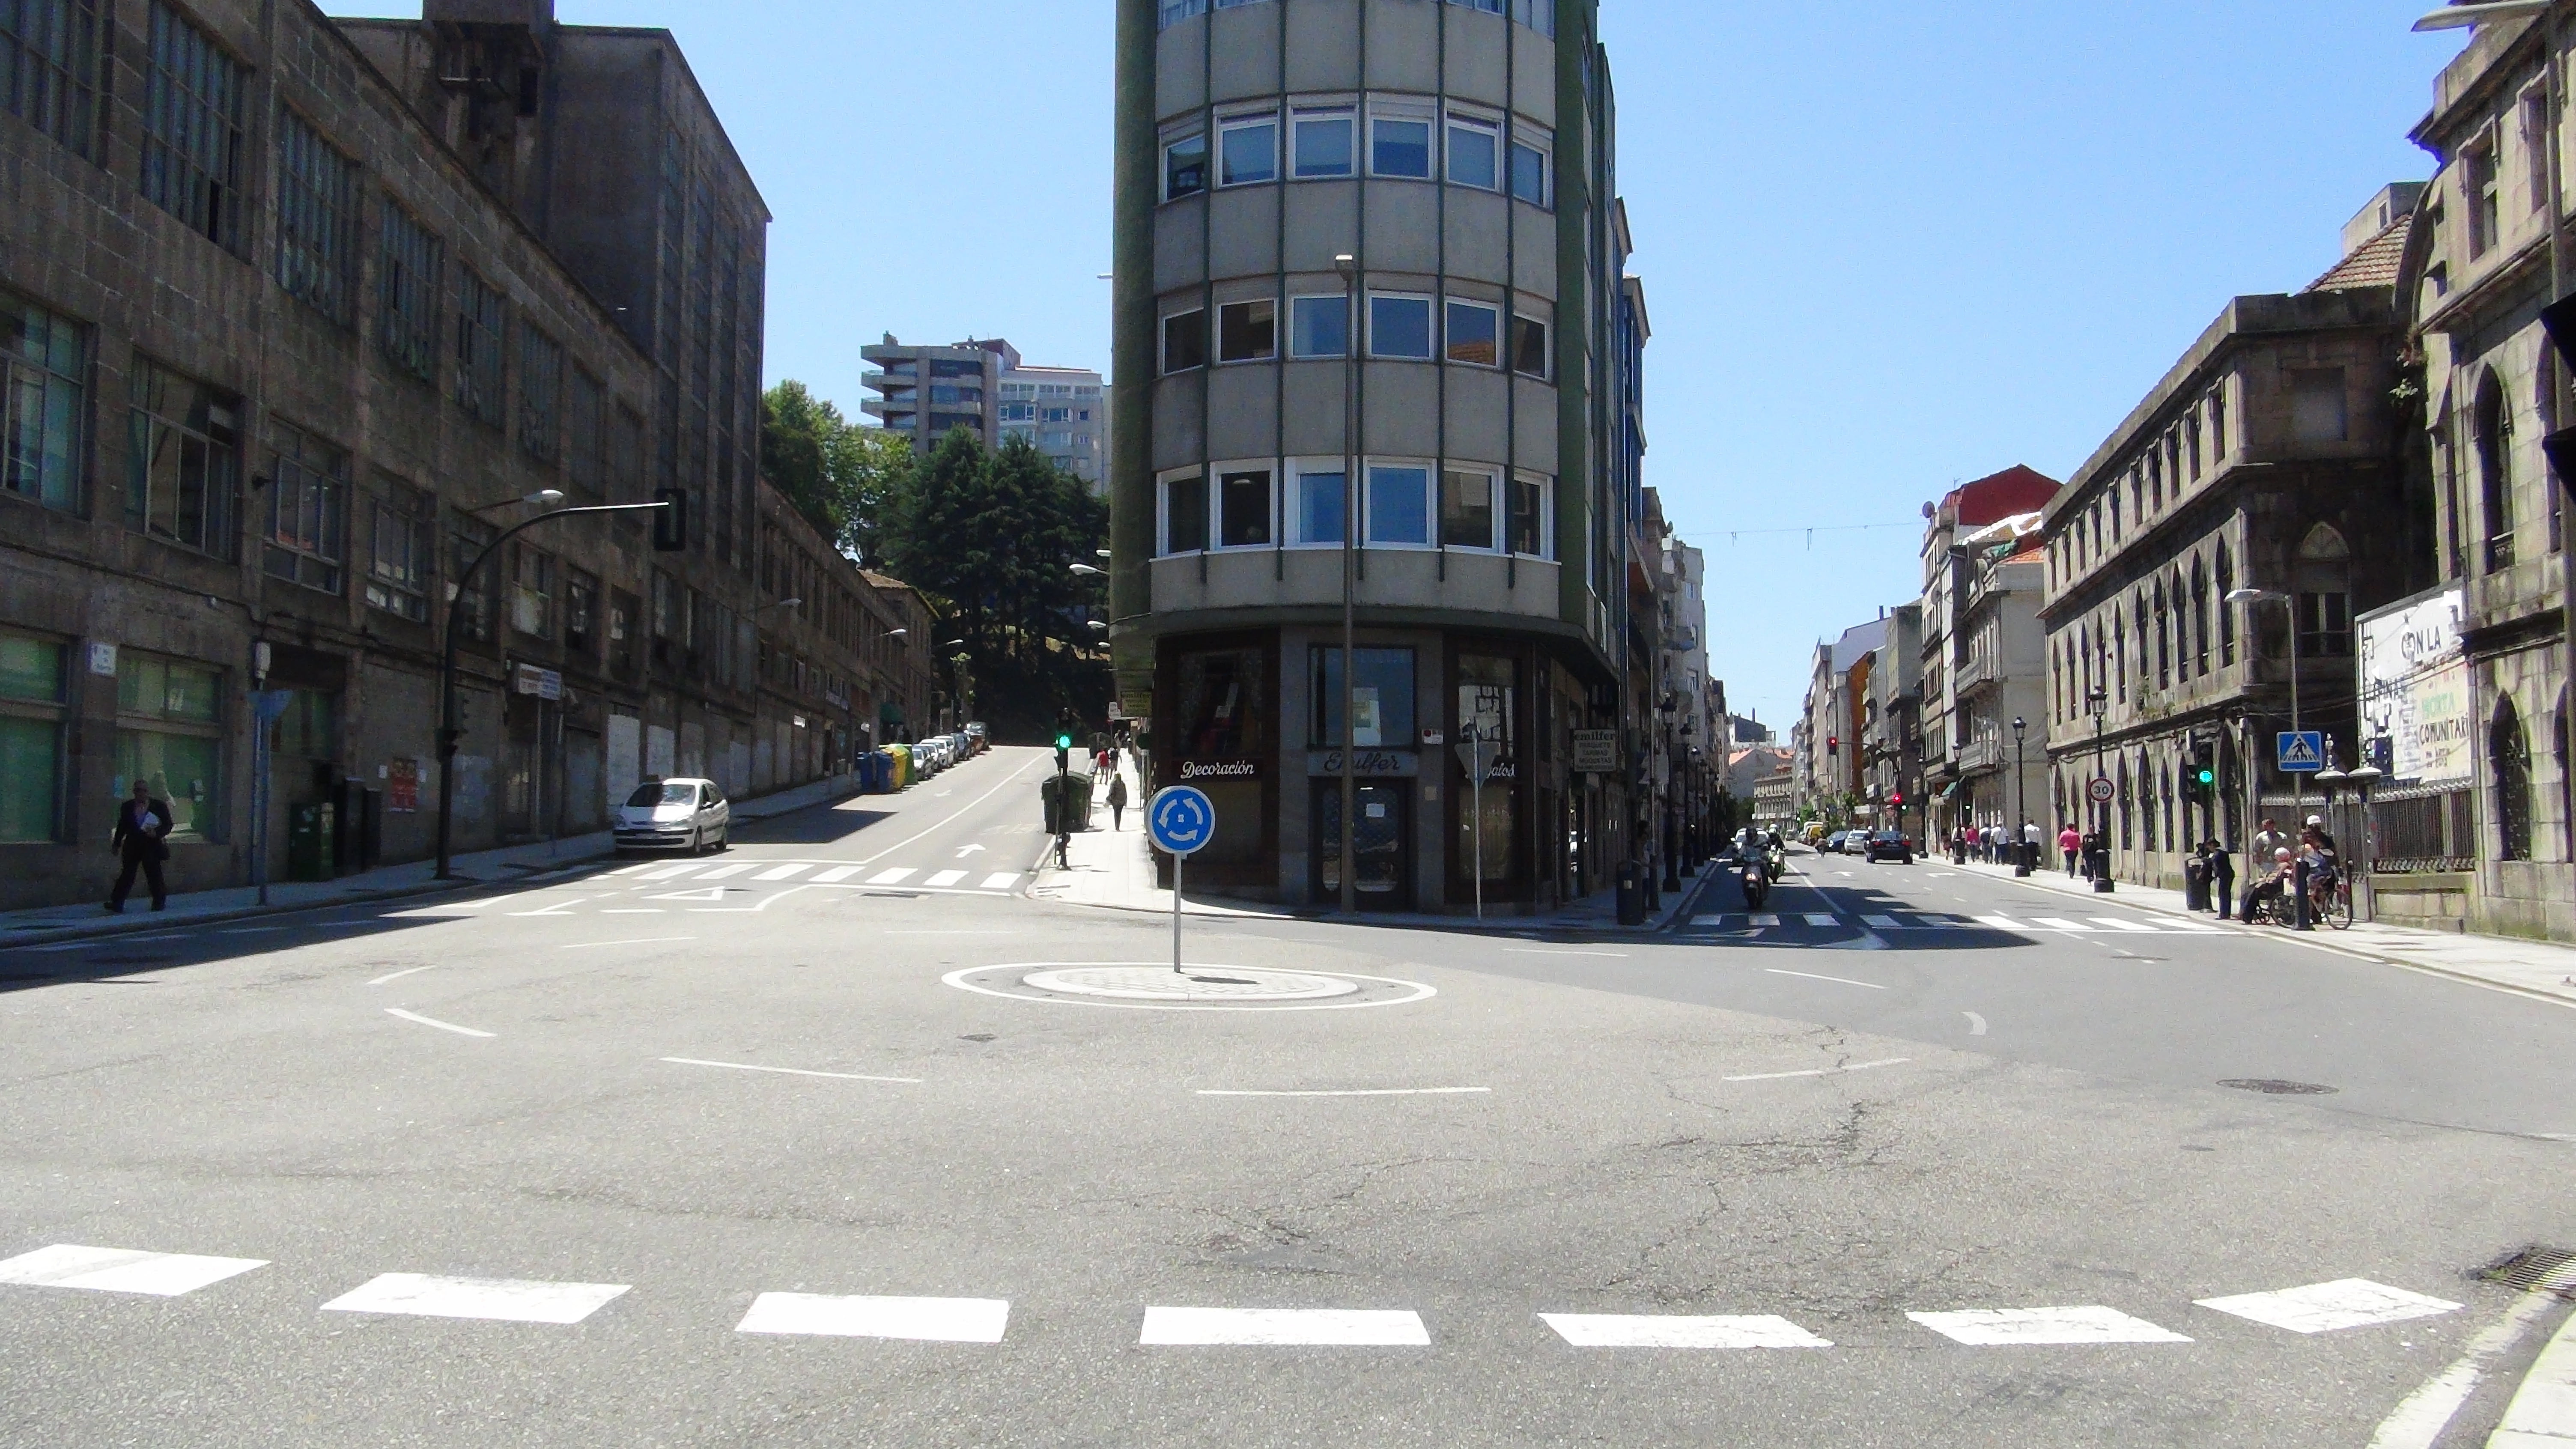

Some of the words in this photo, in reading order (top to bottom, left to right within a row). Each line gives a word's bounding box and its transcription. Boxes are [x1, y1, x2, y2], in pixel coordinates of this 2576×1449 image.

[2427, 626, 2441, 651] LA
[1574, 731, 1615, 740] emilfer
[1181, 760, 1254, 778] Decoración
[1324, 752, 1400, 773] Eilfer
